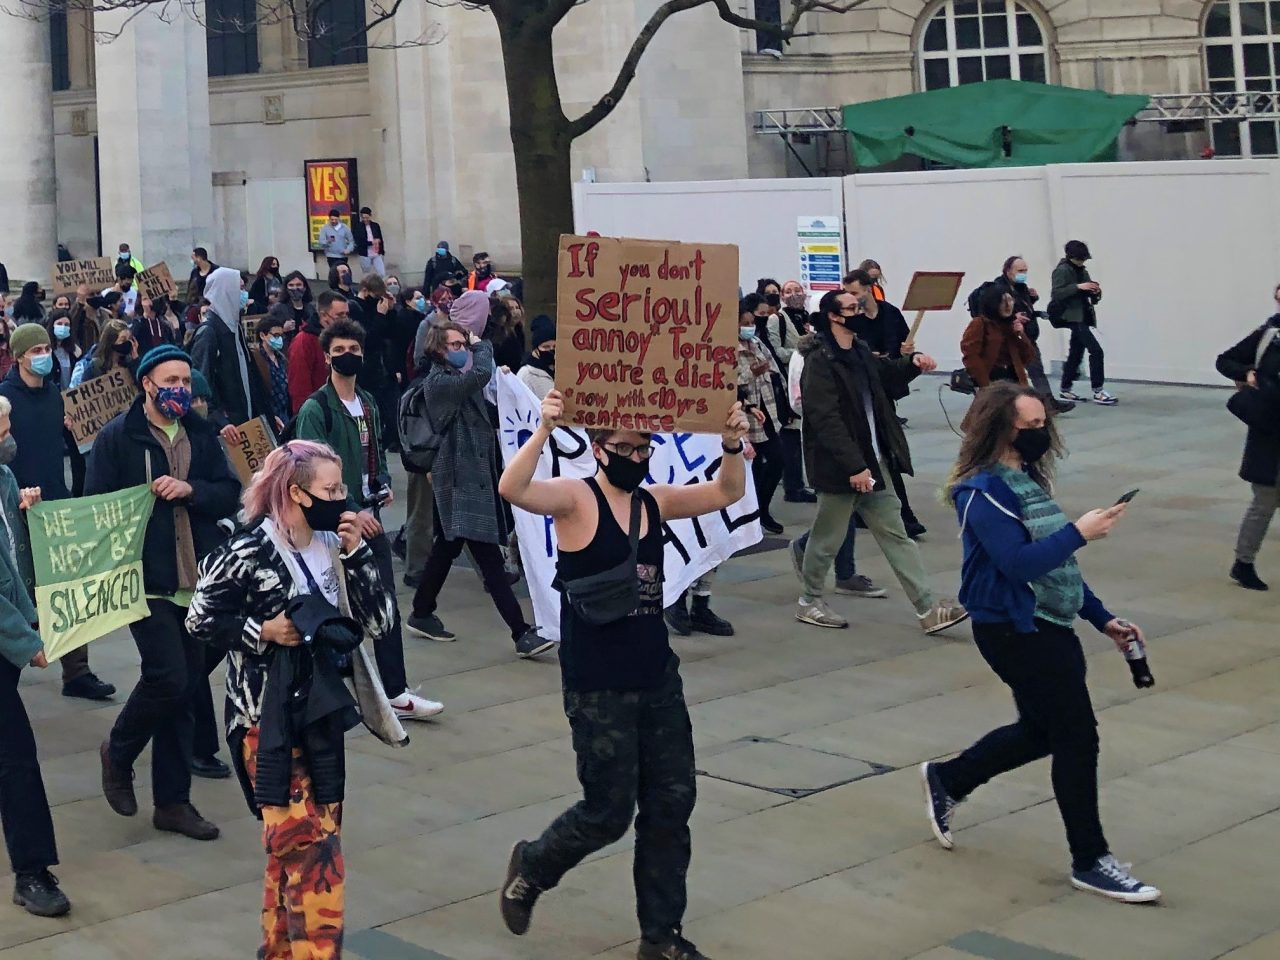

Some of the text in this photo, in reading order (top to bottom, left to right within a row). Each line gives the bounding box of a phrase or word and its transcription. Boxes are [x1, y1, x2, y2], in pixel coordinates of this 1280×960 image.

[309, 166, 348, 202] YES
[56, 260, 100, 274] YOU WILL
[567, 242, 706, 291] If you don't
[669, 326, 739, 369] Tories,
[66, 371, 124, 405] THIS IS
[576, 360, 735, 391] you're a dick.
[67, 397, 101, 423] WHAT
[617, 389, 646, 408] with
[573, 407, 675, 432] sentence
[41, 499, 141, 538] WE WILL
[48, 526, 138, 574] NOT BE
[50, 568, 140, 633] SILENCED
